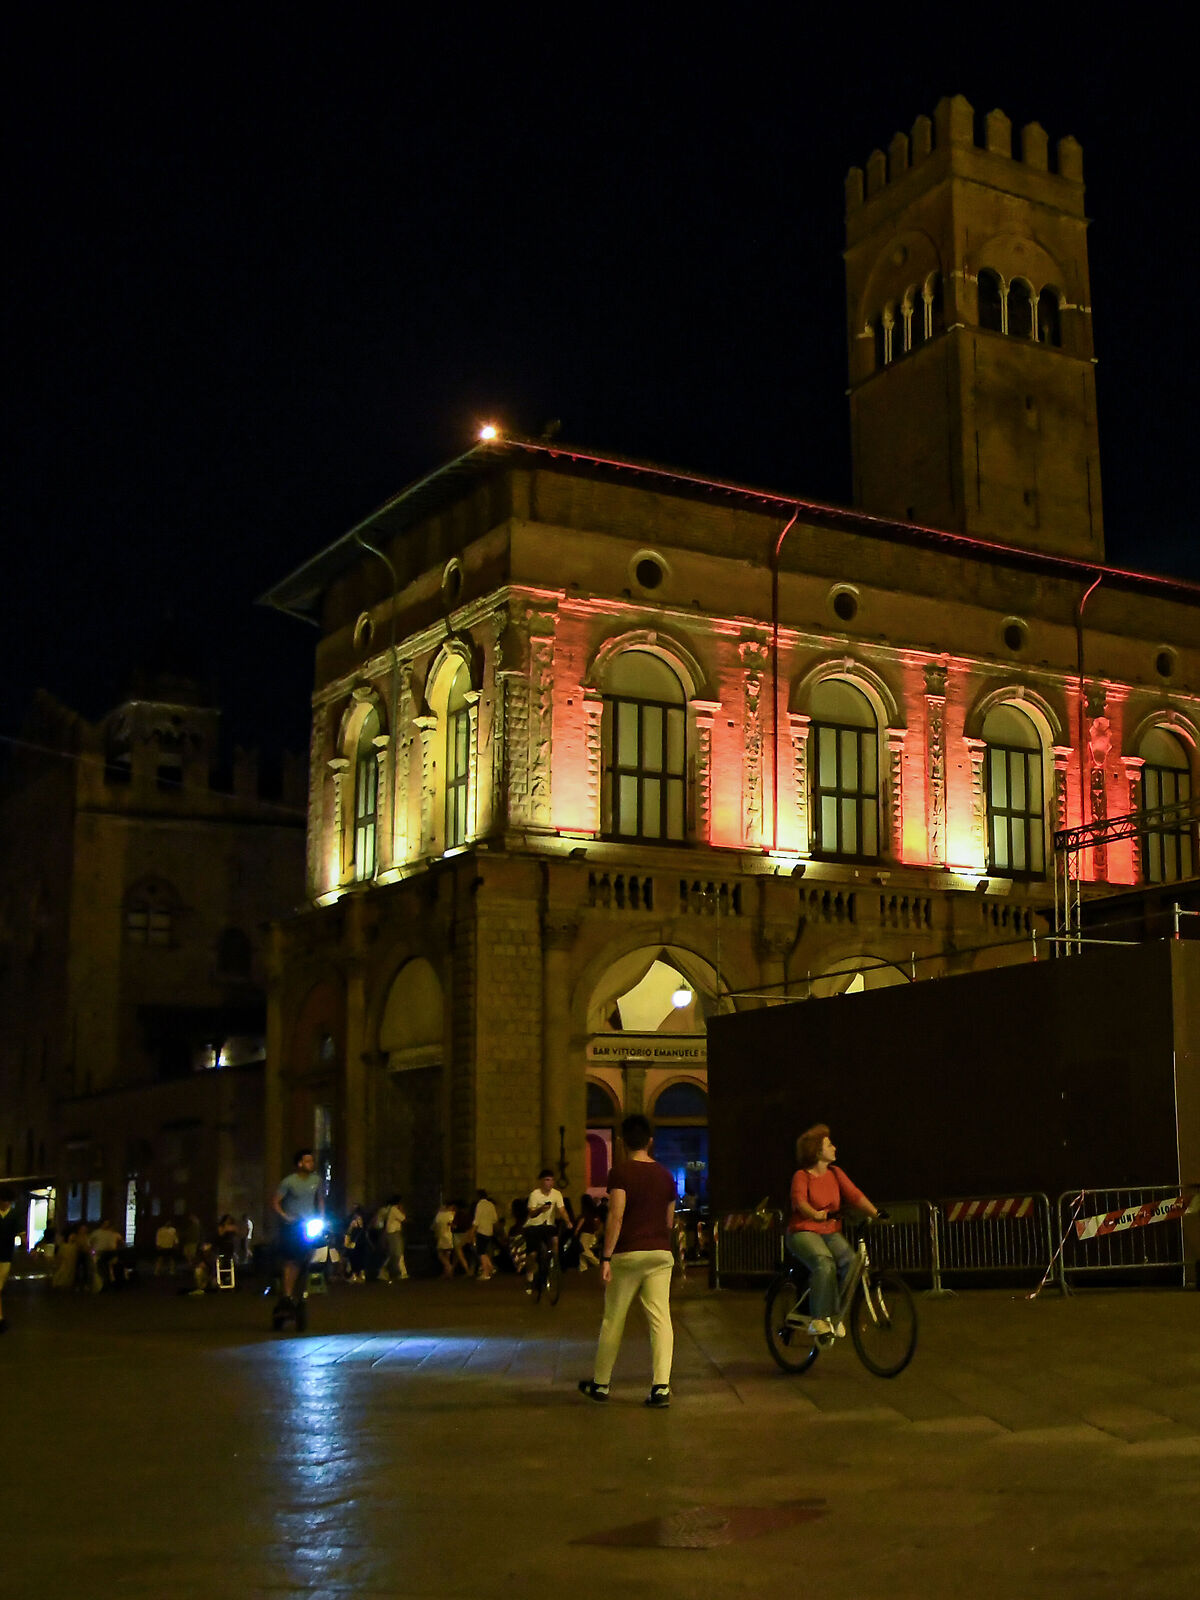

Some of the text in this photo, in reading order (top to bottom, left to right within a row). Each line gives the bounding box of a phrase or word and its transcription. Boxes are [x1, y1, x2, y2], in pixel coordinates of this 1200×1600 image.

[593, 1047, 610, 1056] BAR
[612, 1047, 652, 1057] VITTORIO
[654, 1048, 699, 1057] EMANUELE
